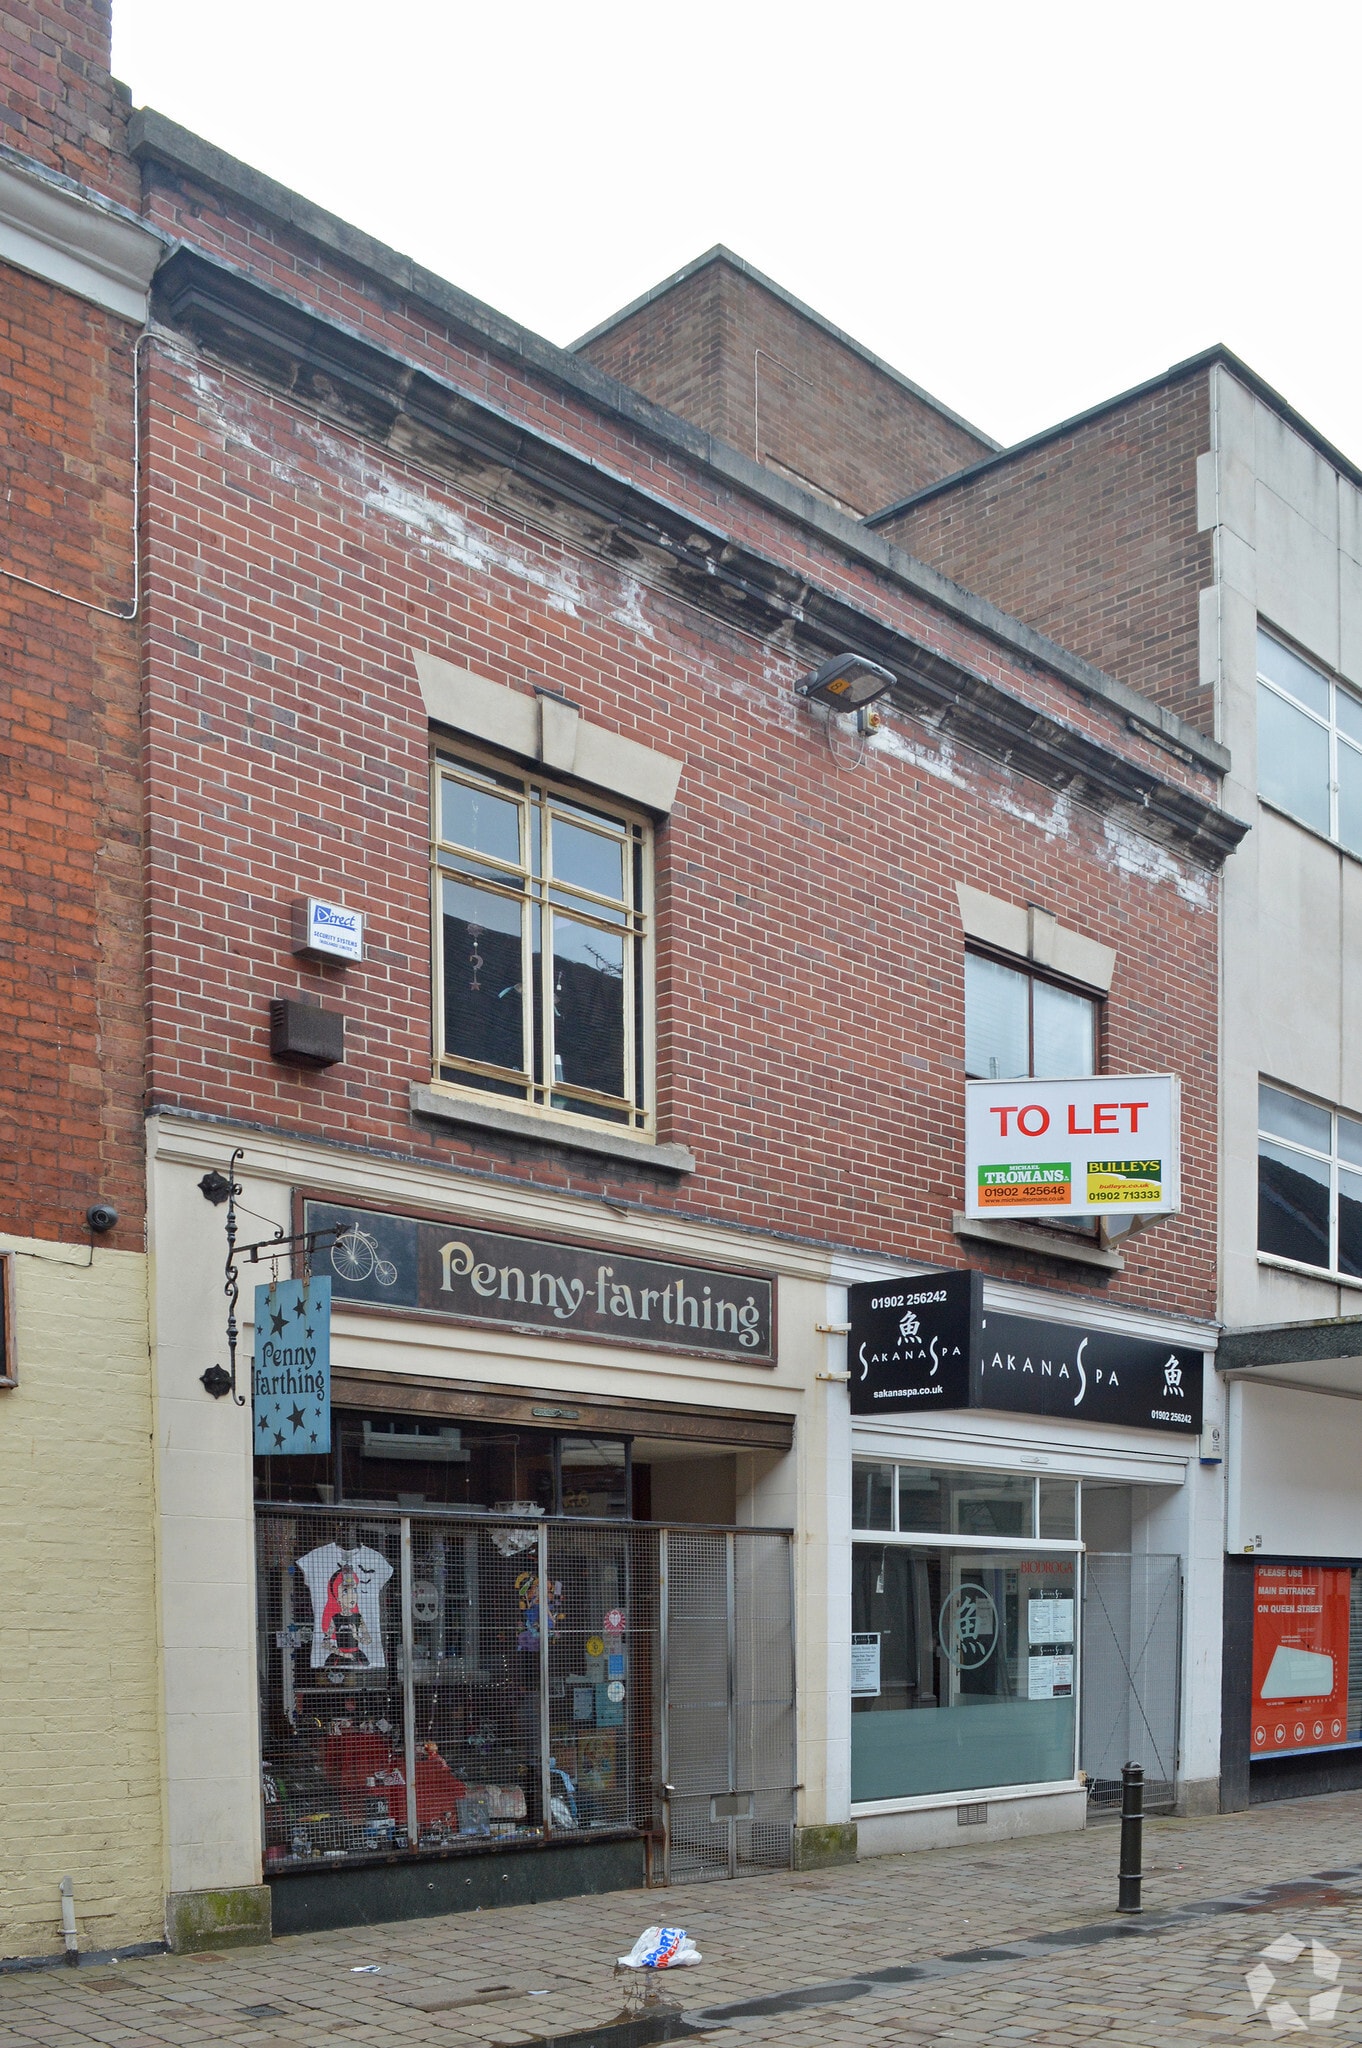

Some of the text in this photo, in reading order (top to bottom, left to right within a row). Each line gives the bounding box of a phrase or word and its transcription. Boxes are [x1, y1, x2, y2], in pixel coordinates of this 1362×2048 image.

[314, 905, 356, 927] Direct
[313, 930, 358, 948] SECURITY SYSTEMS
[989, 1102, 1149, 1137] TO LET
[1088, 1160, 1161, 1173] BULLEYS
[984, 1169, 1064, 1185] TROMANS
[984, 1185, 1065, 1197] 01902 425646
[1098, 1182, 1150, 1190] bulleys.co.uk
[1088, 1190, 1161, 1201] 01902 713333
[438, 1241, 760, 1349] Penny-farthing
[871, 1290, 948, 1310] 01902 256242
[896, 1310, 923, 1347] 魚
[261, 1340, 318, 1373] Penny
[1073, 1336, 1119, 1407] SPA
[1162, 1354, 1185, 1398] 魚
[254, 1366, 326, 1401] farthing
[873, 1385, 944, 1399] sakanaspa.co.uk
[1151, 1409, 1192, 1424] 01902 256242
[1020, 1560, 1073, 1574] BIODROGA
[1258, 1568, 1303, 1578] PLEASE USE
[1258, 1587, 1316, 1596] MAIN ENTRANCE
[1257, 1604, 1323, 1614] ON QUEEN STREET
